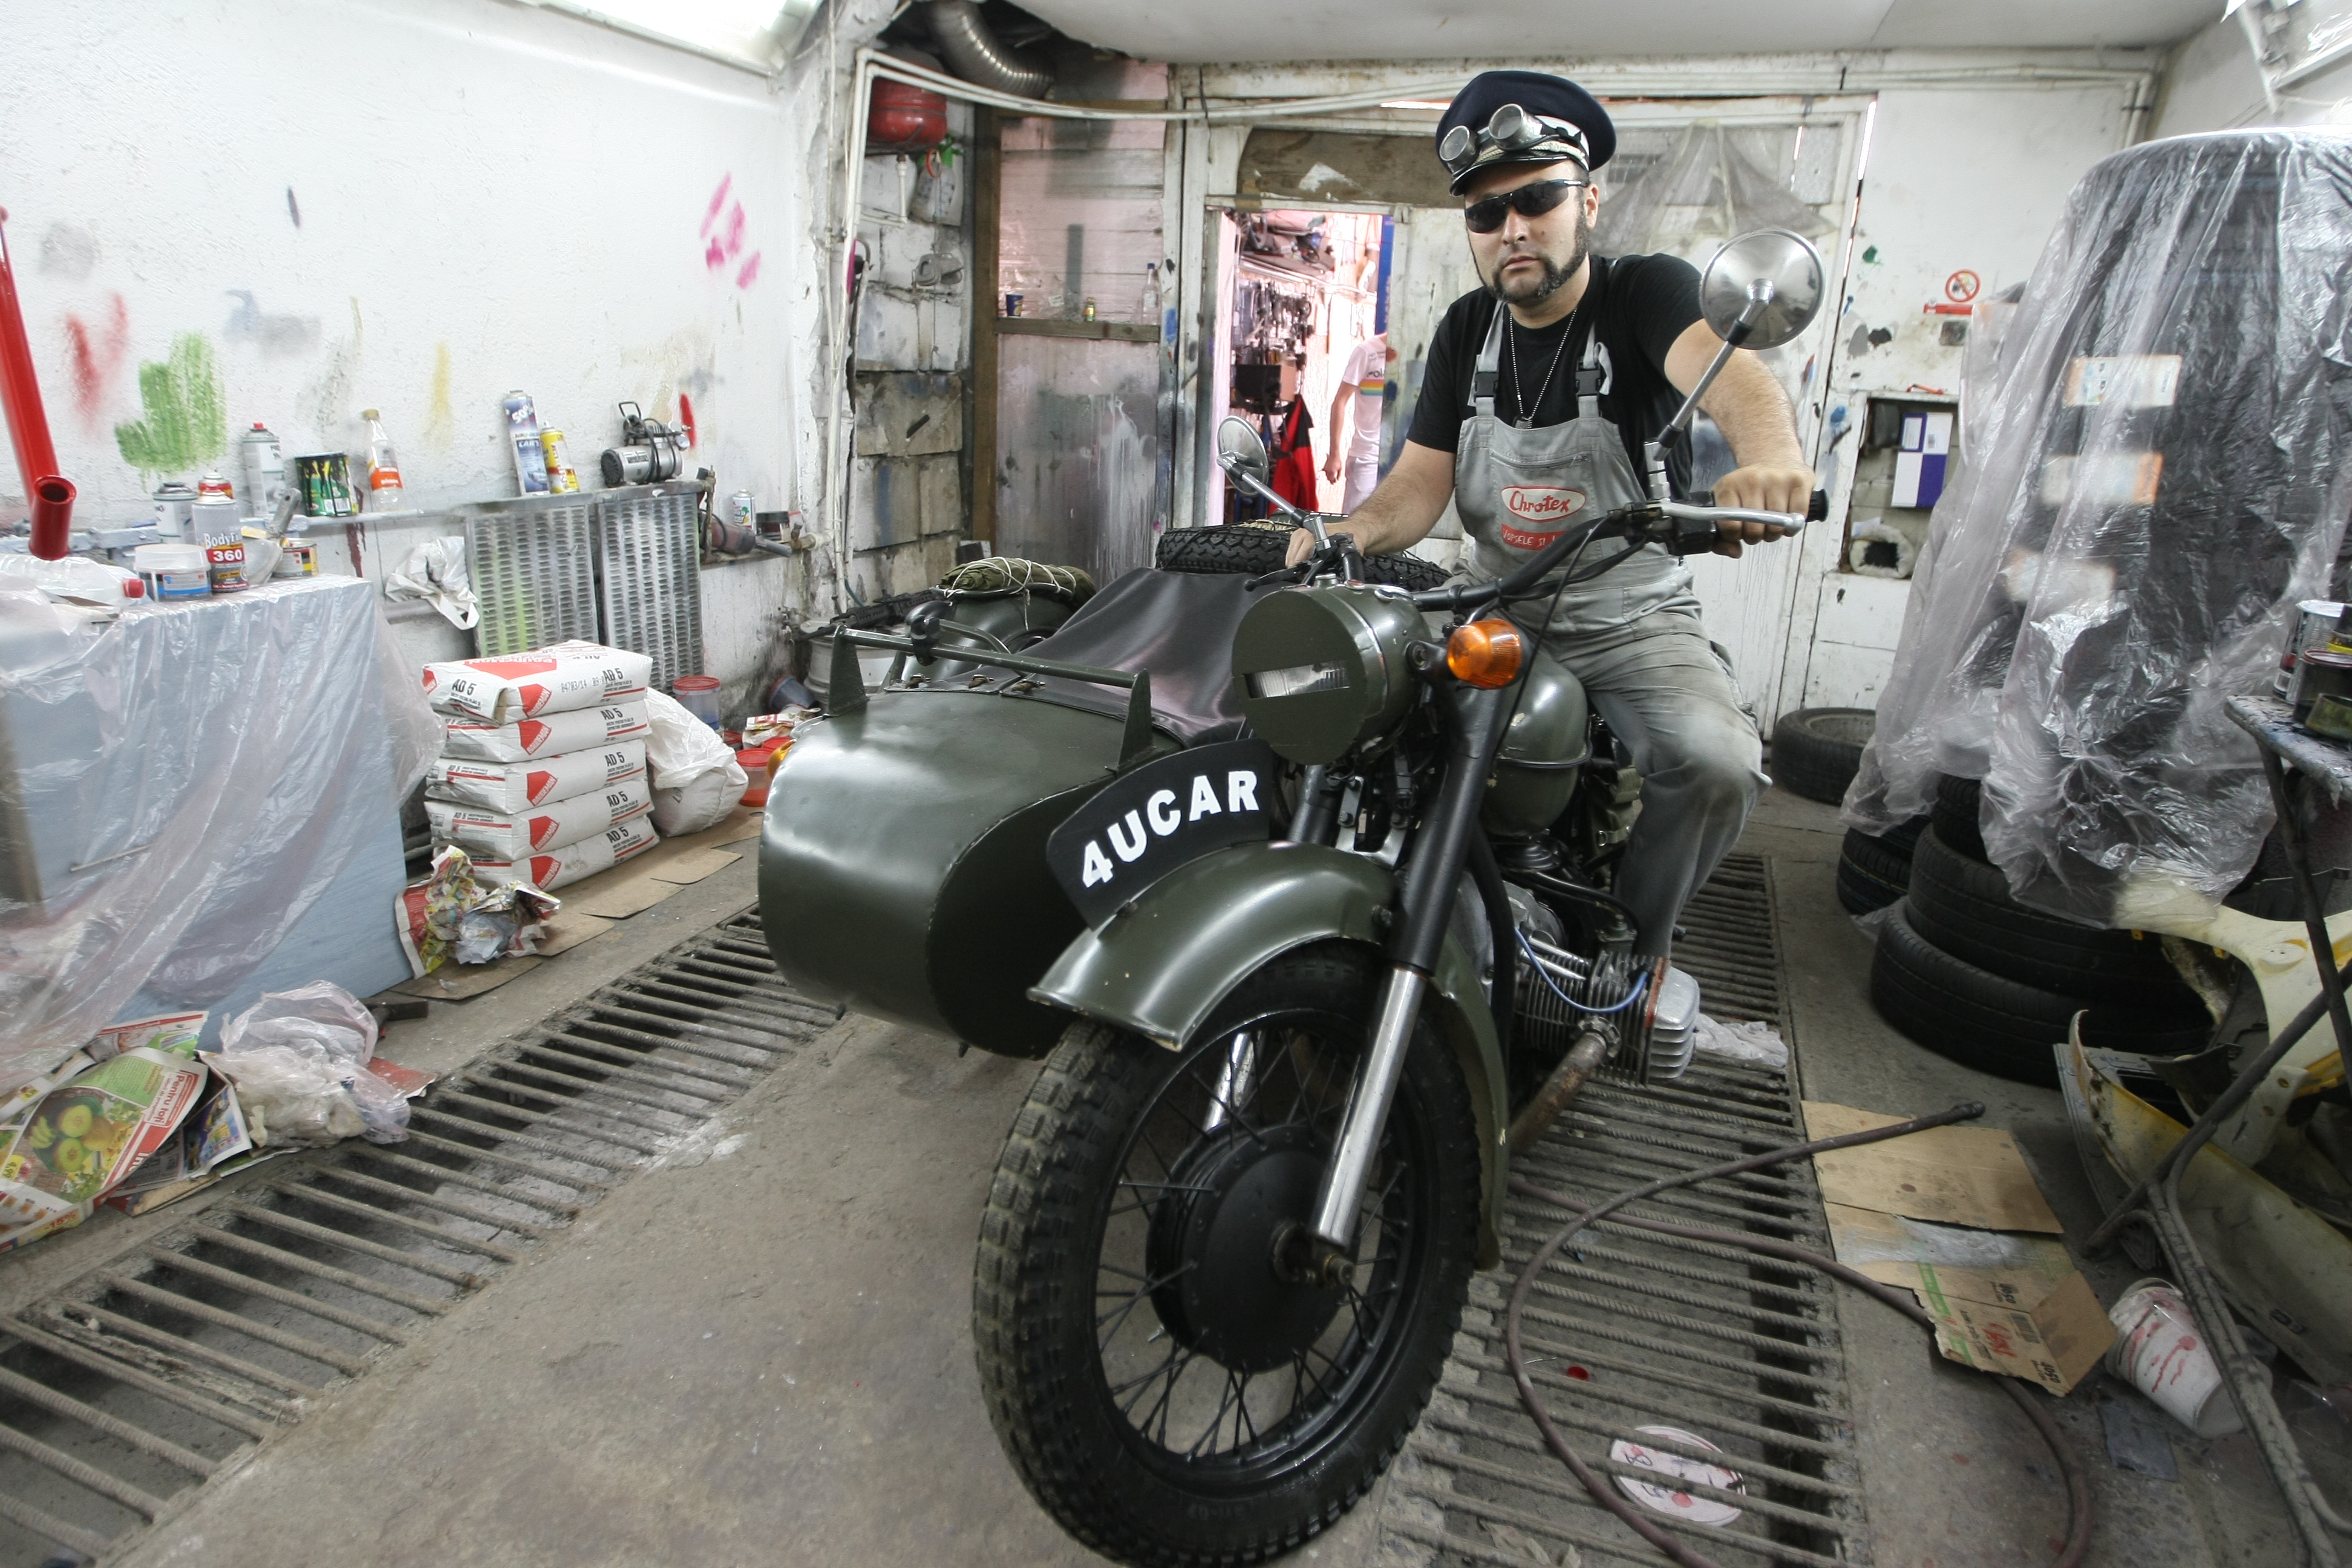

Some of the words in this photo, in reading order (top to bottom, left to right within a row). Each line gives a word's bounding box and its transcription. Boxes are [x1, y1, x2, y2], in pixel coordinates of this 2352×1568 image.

[1509, 490, 1571, 513] Chrotex
[1503, 529, 1534, 546] VOPSELE
[213, 549, 243, 562] 360
[603, 670, 616, 682] AD
[615, 667, 624, 680] 5
[452, 678, 467, 693] AD
[466, 683, 477, 696] 5
[601, 709, 615, 720] AD
[613, 708, 623, 718] 5
[605, 754, 617, 767] AD
[617, 751, 625, 763] 5
[607, 794, 619, 808] AD
[619, 791, 629, 803] 5
[606, 831, 621, 843] AD
[620, 826, 629, 837] 5
[1082, 770, 1259, 888] 4UCAR
[163, 1075, 185, 1106] Pentru
[2040, 1362, 2062, 1383] 4050
